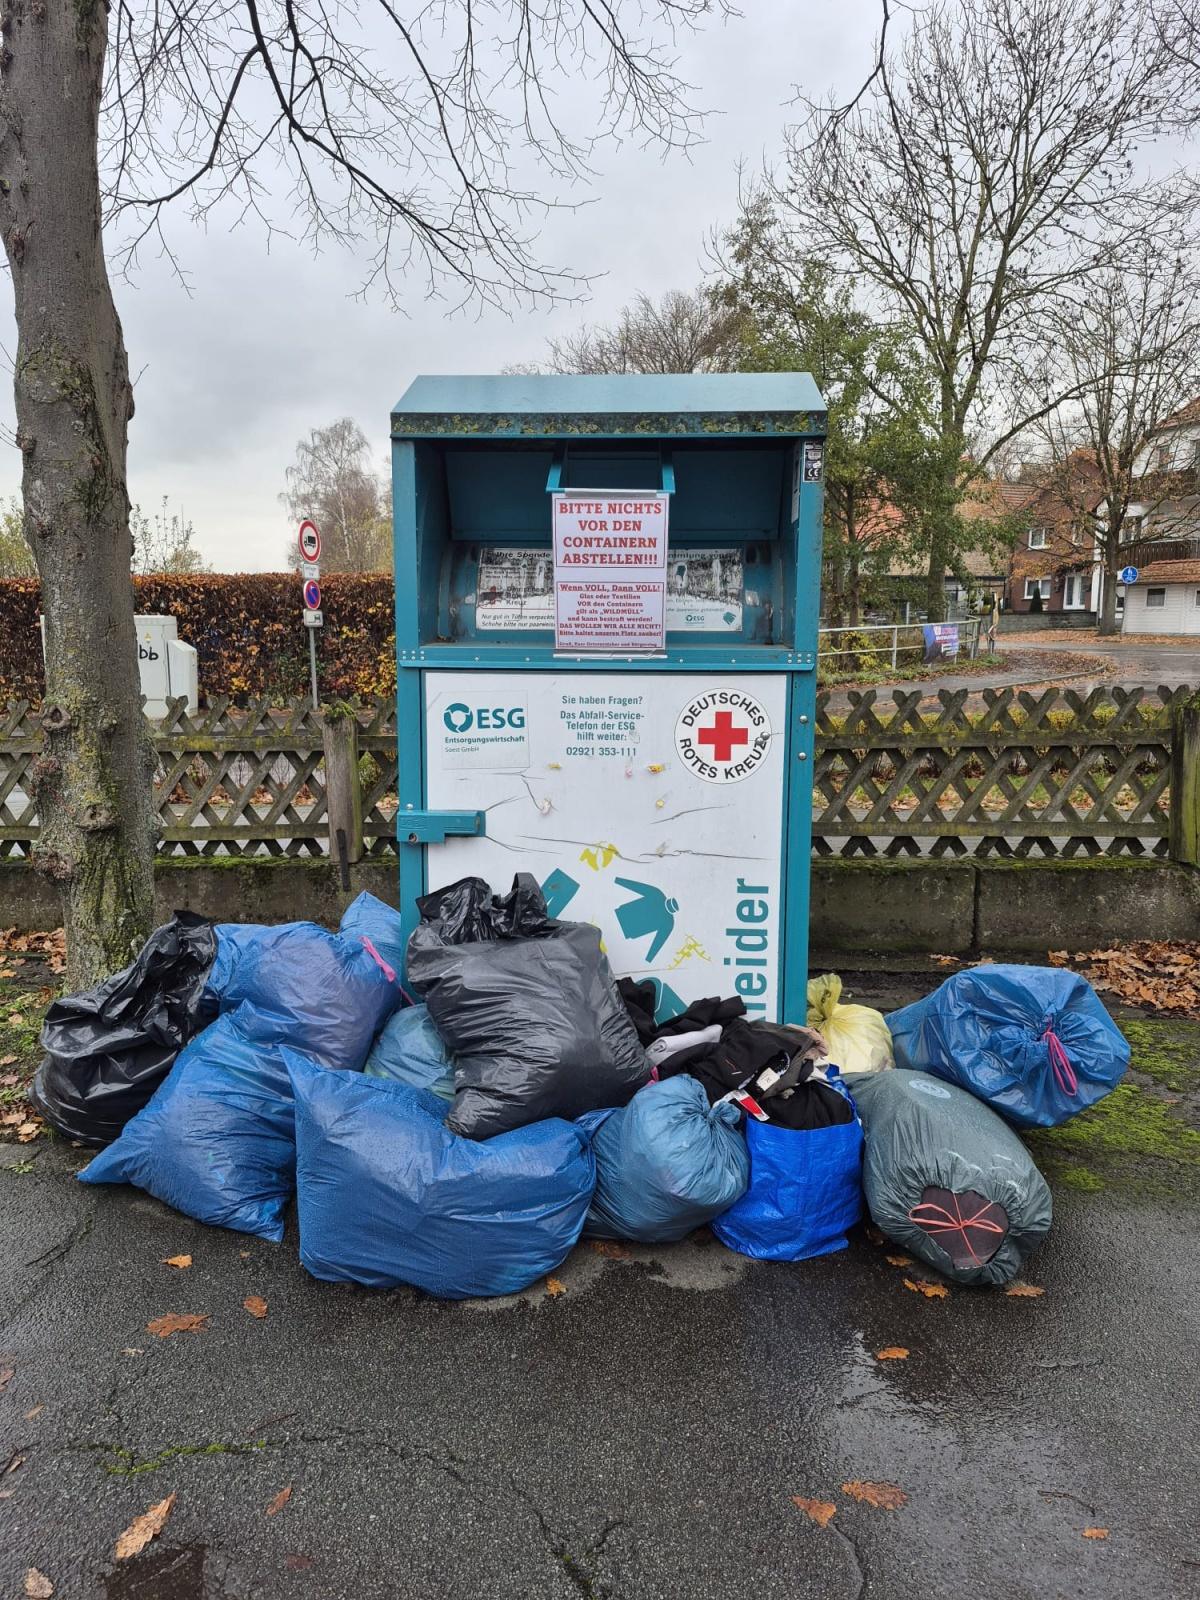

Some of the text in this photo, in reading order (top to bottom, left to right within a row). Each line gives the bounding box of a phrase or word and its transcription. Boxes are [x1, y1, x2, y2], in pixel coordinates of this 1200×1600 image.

[559, 503, 662, 514] BITTE NICHTS
[578, 520, 642, 531] VOR DEN
[563, 537, 657, 548] CONTAINERN
[562, 553, 658, 565] ABSTELLEN!!!
[560, 584, 660, 592] Wenn VOLL, Dann VOLL!
[561, 695, 643, 707] Sie haben Fragen?
[560, 710, 645, 720] Das Abfall-Service-
[681, 692, 765, 727] DEUTSCHES
[476, 707, 526, 730] ESG
[566, 721, 636, 731] Telefon der ESG
[444, 735, 525, 745] Entsorgungswirtschaft
[576, 731, 627, 741] hilft weiter:
[461, 745, 480, 753] GmbH
[566, 746, 637, 757] 02921 353-111
[679, 737, 718, 779] ROTES
[723, 877, 770, 1022] leider
